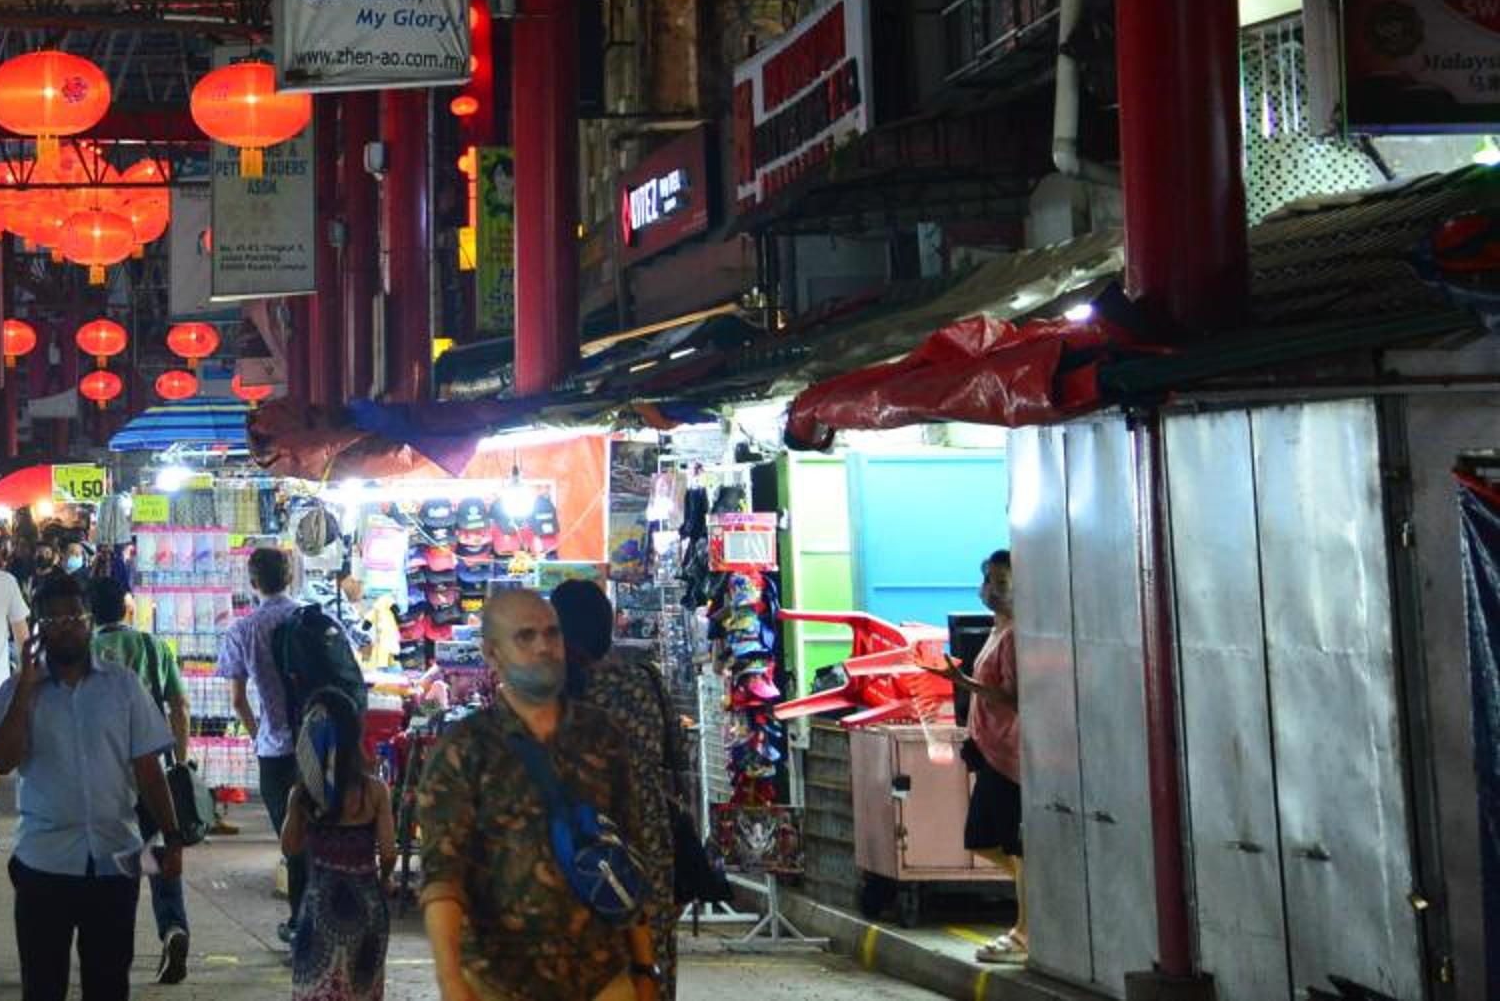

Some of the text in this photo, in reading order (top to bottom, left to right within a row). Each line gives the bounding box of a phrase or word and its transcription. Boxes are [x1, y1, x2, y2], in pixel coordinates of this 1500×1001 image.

[356, 9, 387, 29] My
[392, 9, 451, 34] Glory
[295, 46, 469, 75] www.zhen-ao.com.my
